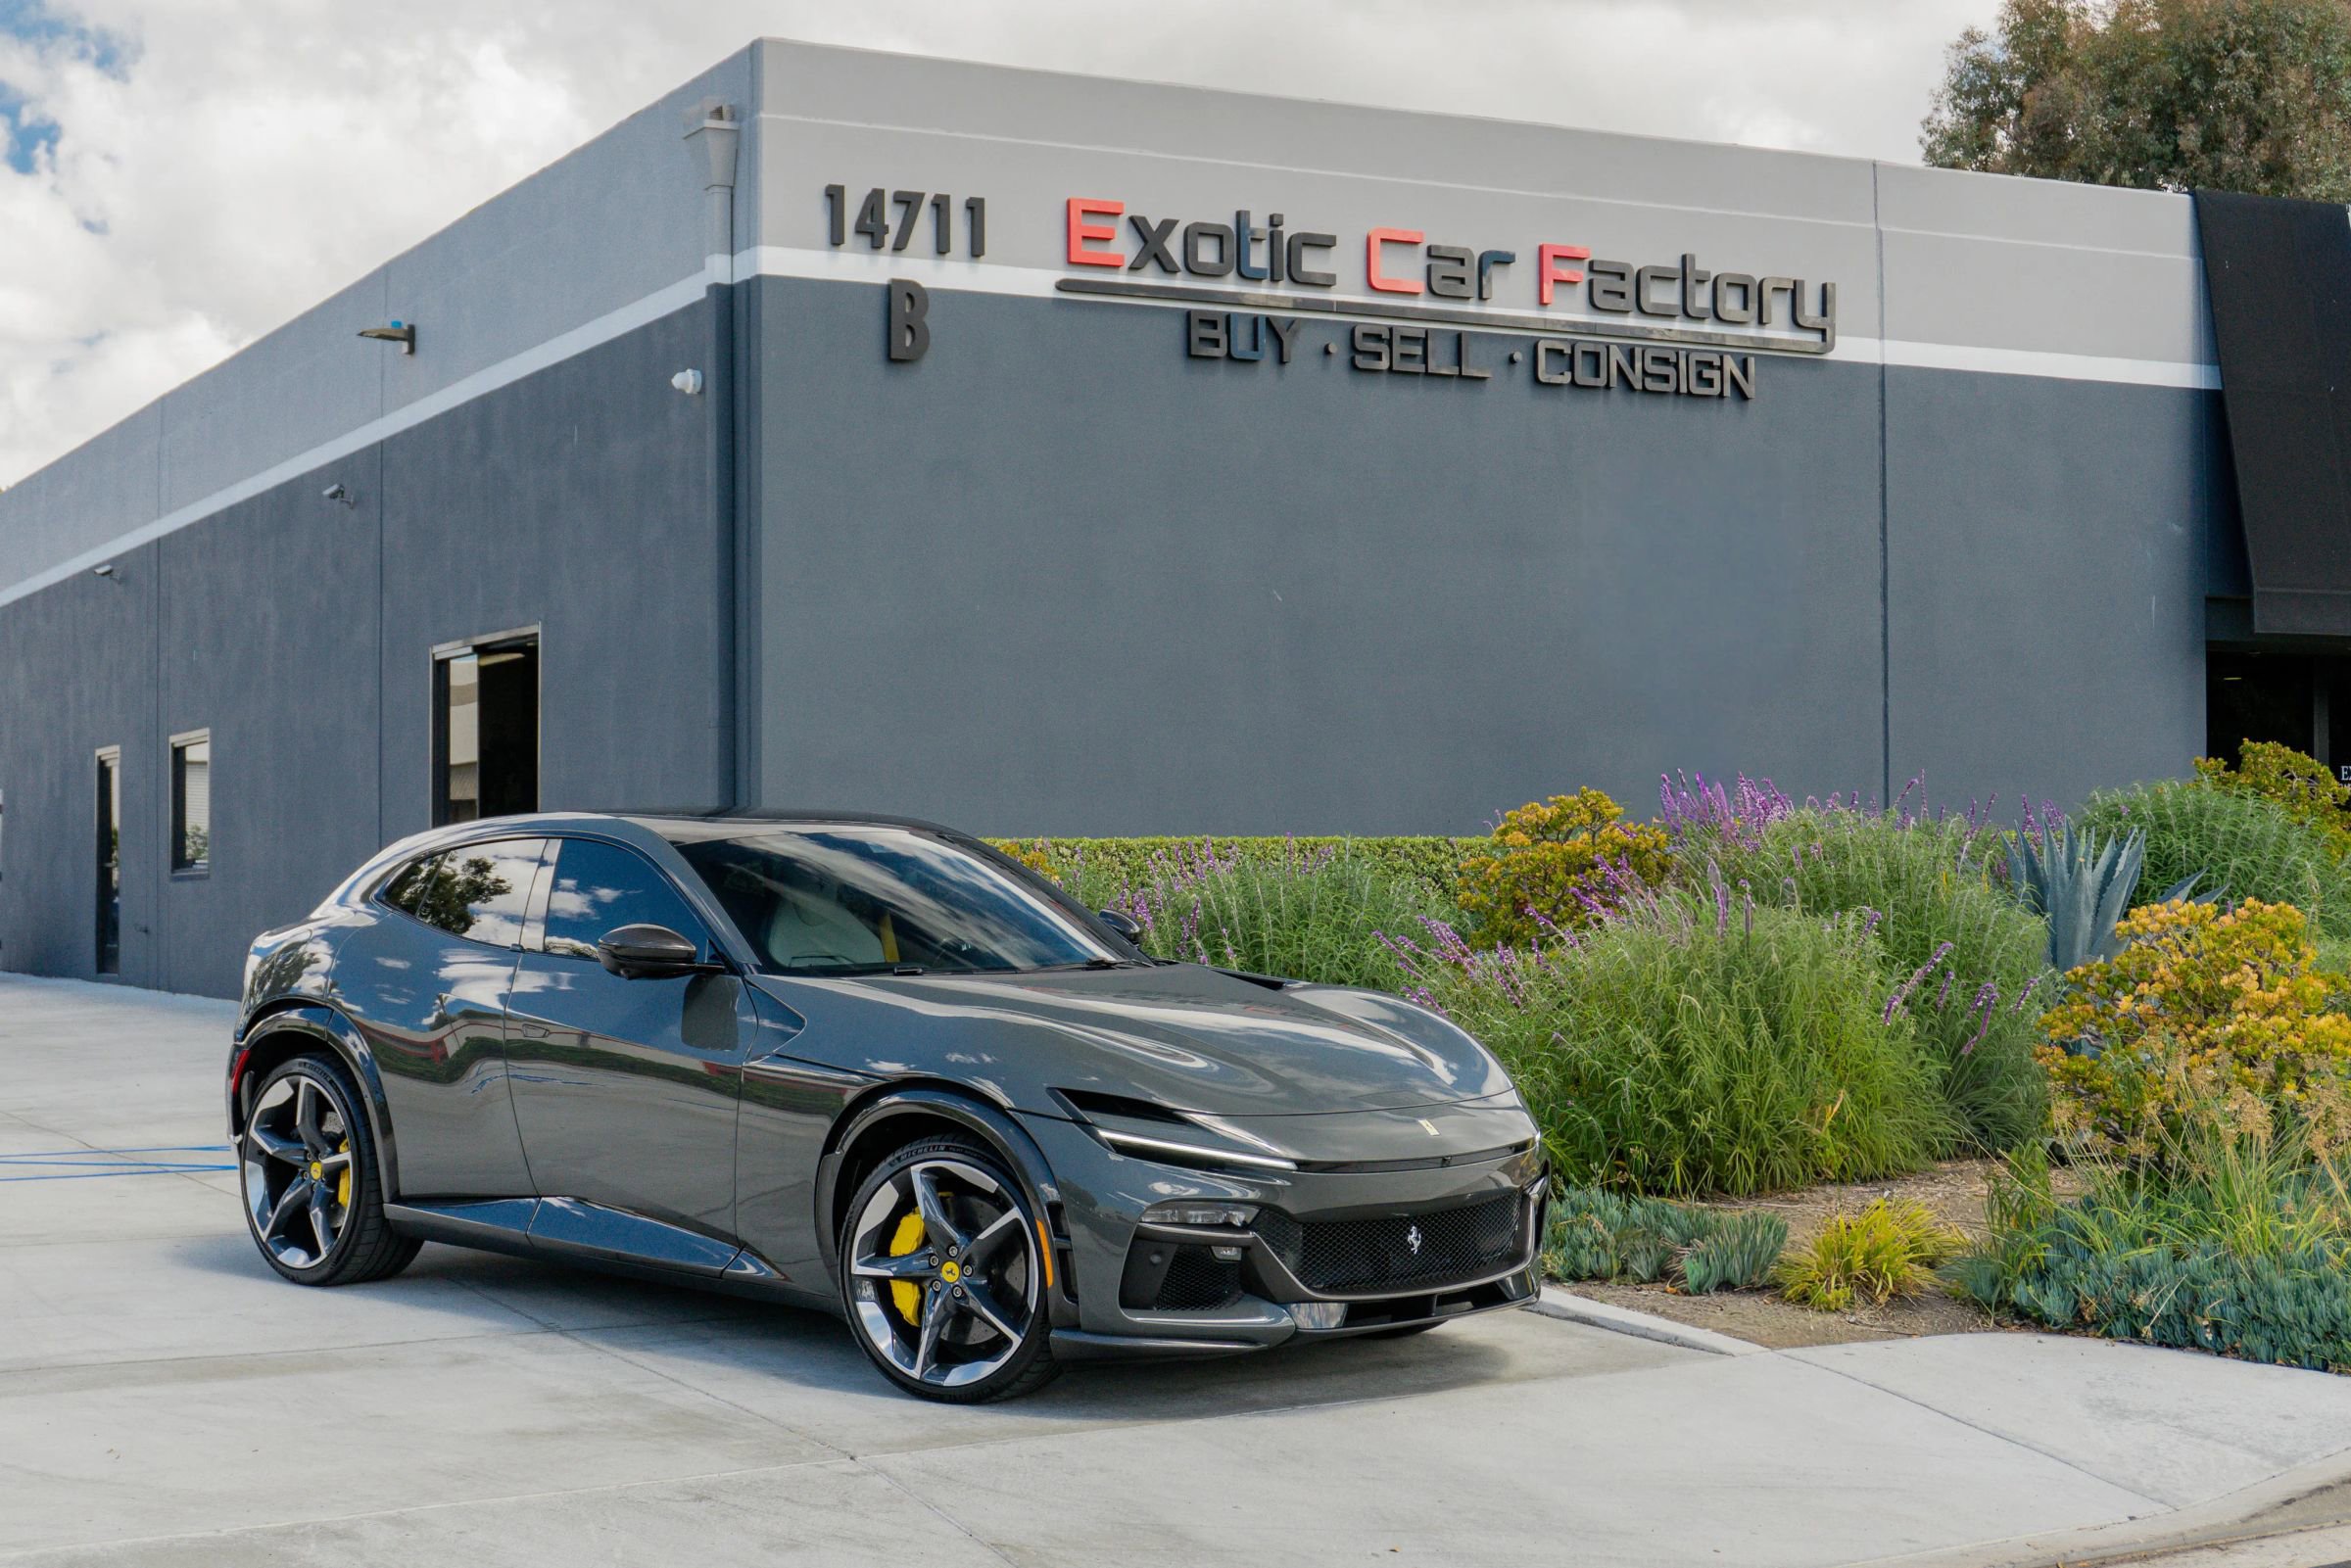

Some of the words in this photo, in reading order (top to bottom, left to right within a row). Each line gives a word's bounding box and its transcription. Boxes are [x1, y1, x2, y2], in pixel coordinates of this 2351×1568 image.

[825, 184, 985, 258] 14711
[888, 278, 931, 361] B
[1066, 197, 1338, 287] Exotic
[1366, 226, 1516, 300] Car
[1538, 242, 1837, 355] Factory
[1186, 309, 1302, 364] BUY
[1350, 323, 1493, 379] SELL
[1534, 338, 1756, 400] CONSIGN
